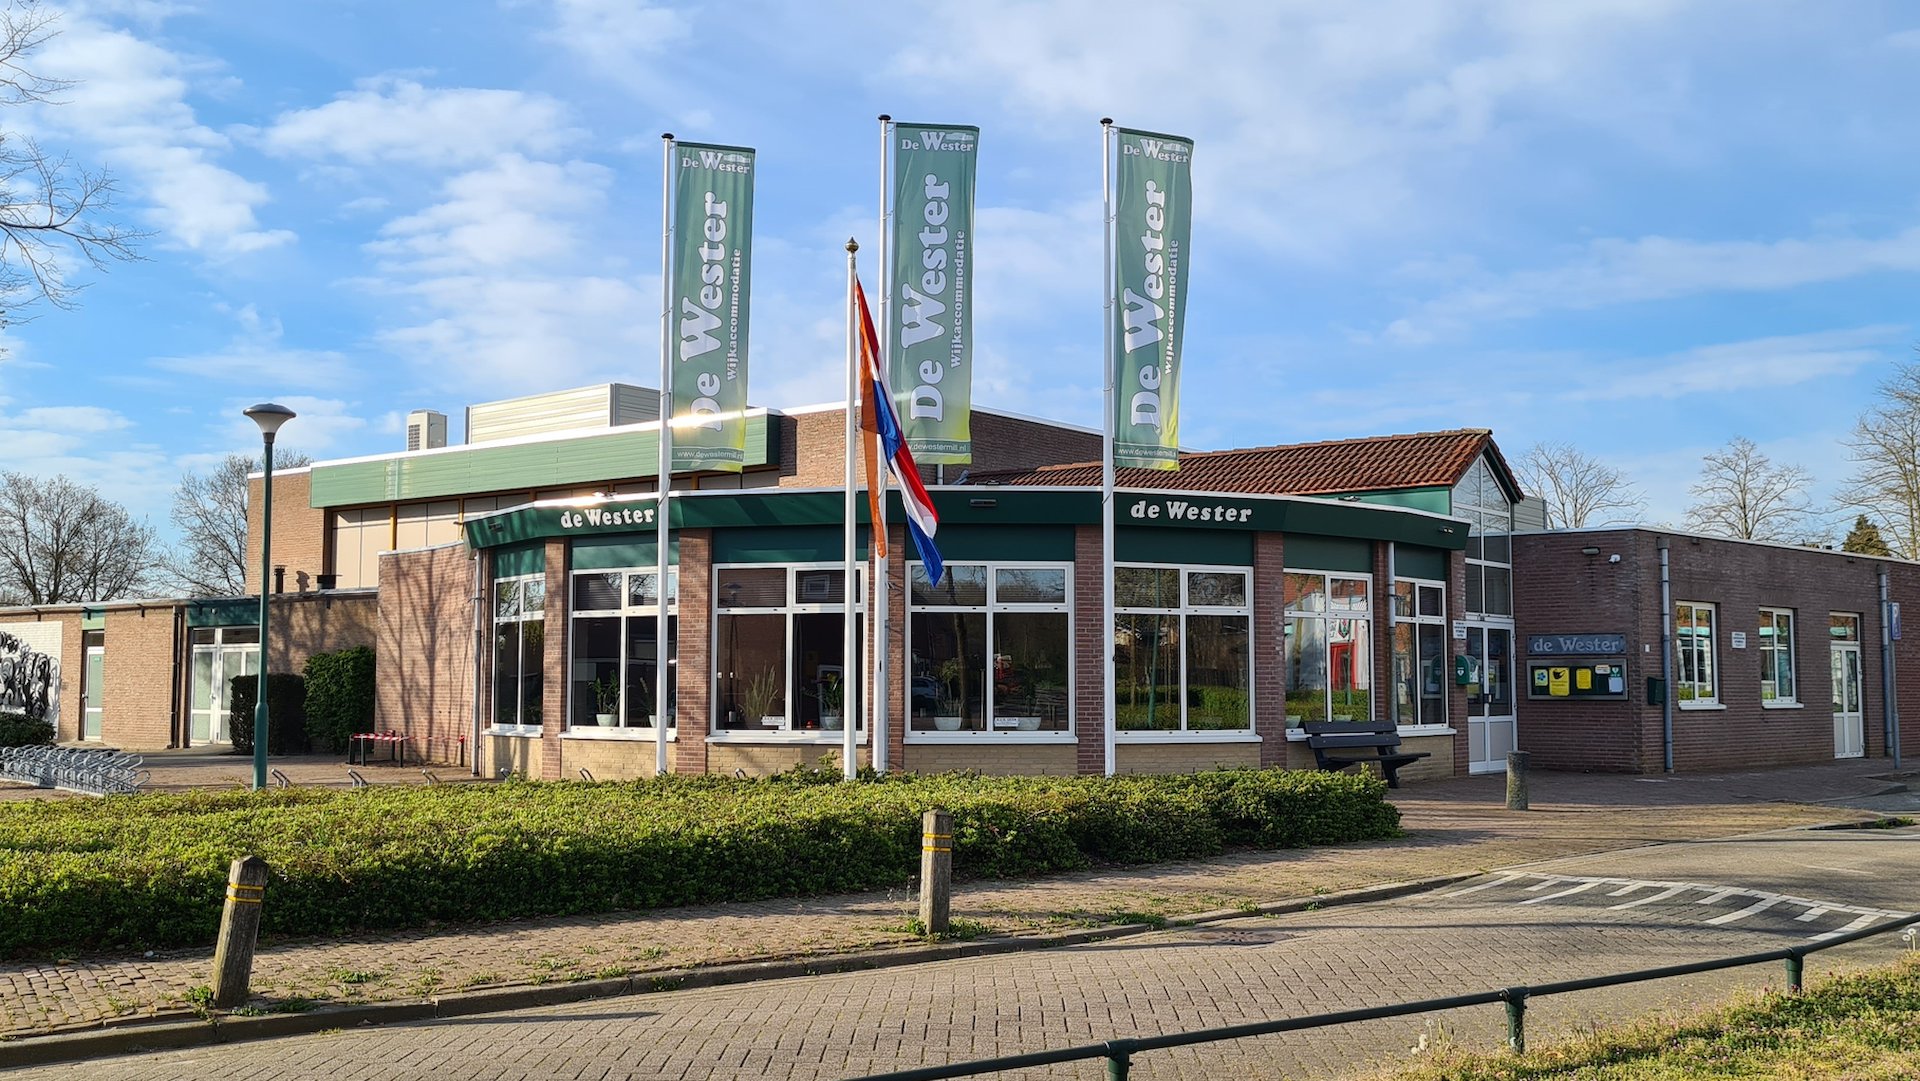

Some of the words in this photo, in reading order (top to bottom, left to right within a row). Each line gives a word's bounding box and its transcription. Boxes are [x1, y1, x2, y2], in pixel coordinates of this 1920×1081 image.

[682, 157, 699, 168] De
[699, 151, 750, 174] Wester
[902, 139, 919, 150] De
[920, 132, 974, 152] Wester
[1123, 144, 1140, 156] De
[1140, 138, 1188, 163] Wester
[680, 191, 727, 362] Wester
[901, 174, 949, 349] Wester
[1123, 180, 1165, 354] Wester
[690, 372, 723, 432] De
[910, 359, 945, 423] De
[1131, 365, 1161, 434] De
[560, 510, 583, 529] de
[584, 508, 655, 527] Wester
[1130, 500, 1160, 519] de
[1166, 501, 1252, 522] Wester
[1534, 638, 1553, 652] de
[1558, 637, 1620, 651] Wester
